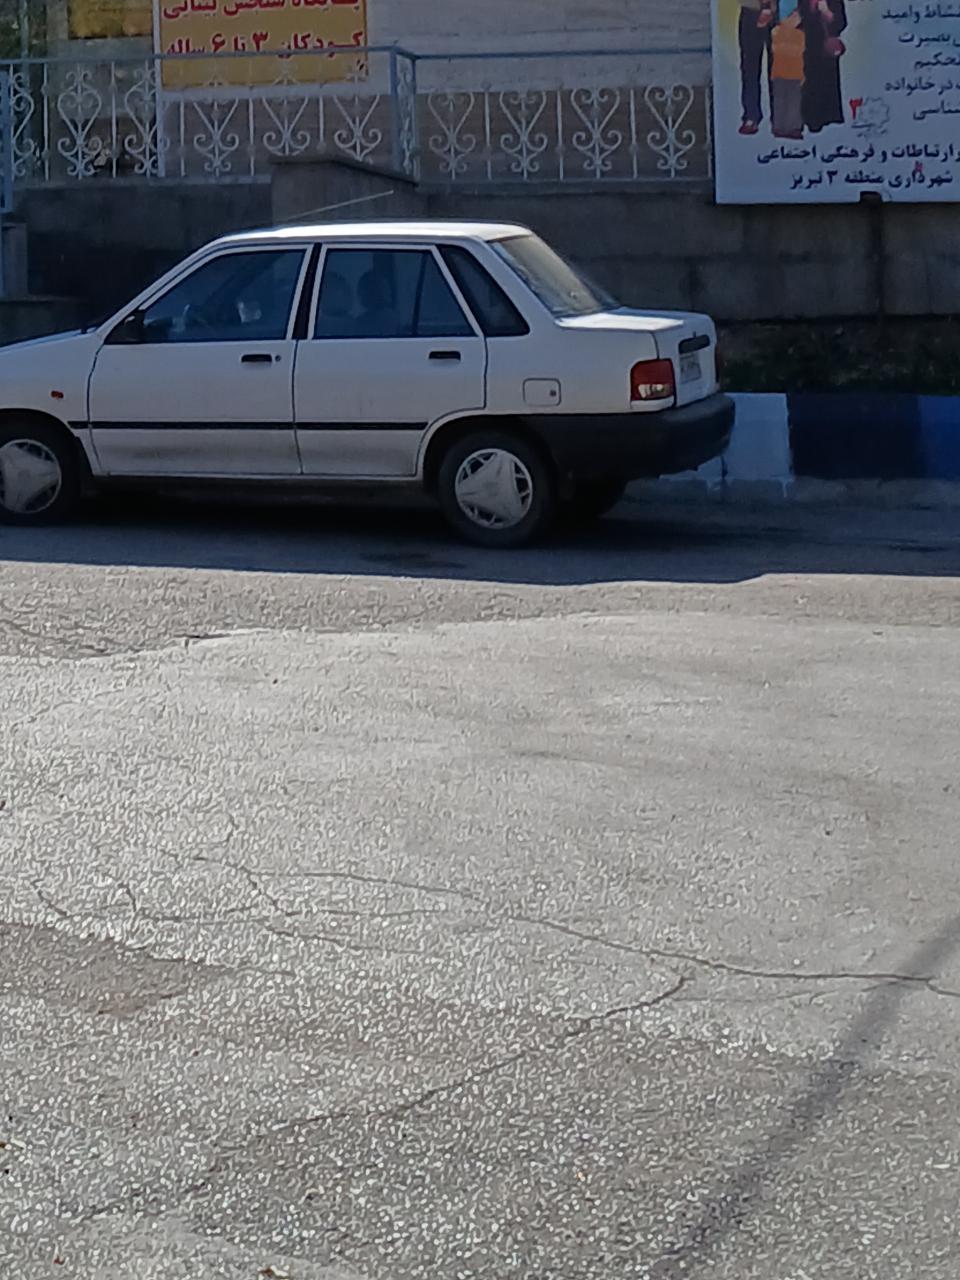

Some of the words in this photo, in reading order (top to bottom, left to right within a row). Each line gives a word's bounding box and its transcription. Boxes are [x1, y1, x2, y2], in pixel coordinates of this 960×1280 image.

[210, 33, 227, 54] ۶
[252, 31, 269, 53] ۳
[277, 31, 363, 59] کودکان
[757, 145, 816, 164] اجتماعی
[820, 143, 876, 164] فرهنگی
[790, 172, 823, 190] تبریز
[826, 170, 838, 185] ۳
[844, 170, 884, 185] منطقه
[889, 168, 953, 189] شهرداری
